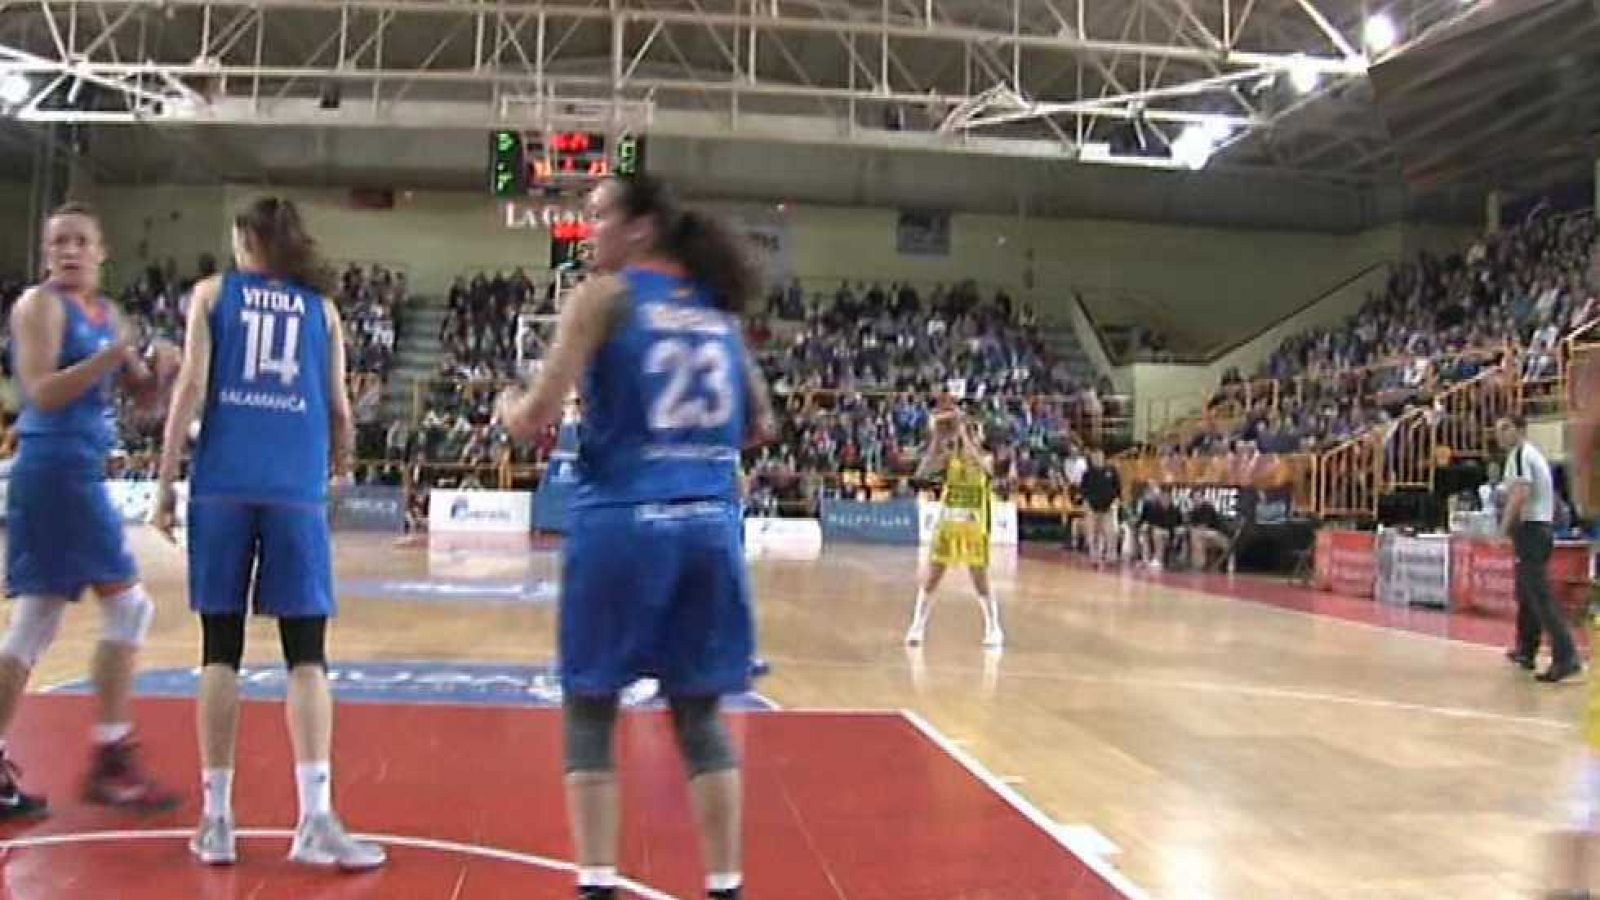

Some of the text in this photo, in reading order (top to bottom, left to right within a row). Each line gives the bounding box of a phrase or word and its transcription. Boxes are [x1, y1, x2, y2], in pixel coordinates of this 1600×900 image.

[242, 287, 306, 315] VITOLA
[240, 309, 300, 386] 14
[219, 390, 307, 413] SALAMANCA
[644, 338, 733, 429] 23
